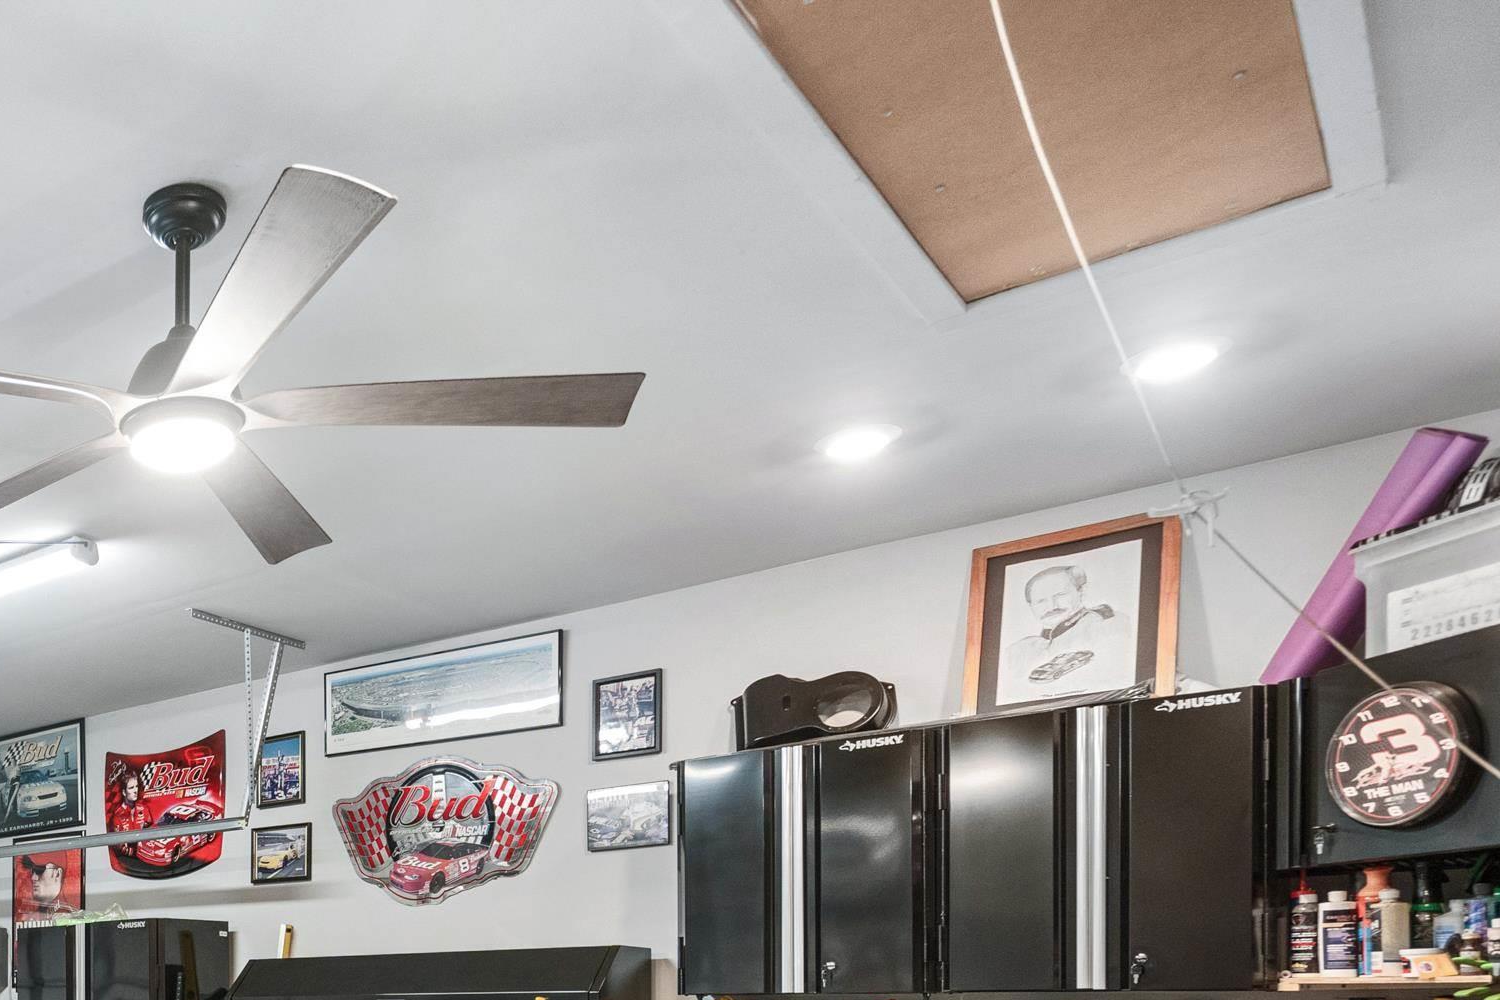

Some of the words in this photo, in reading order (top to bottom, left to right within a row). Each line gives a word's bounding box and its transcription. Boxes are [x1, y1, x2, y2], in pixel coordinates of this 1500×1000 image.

[1177, 690, 1242, 711] HUSKY
[1379, 695, 1400, 708] 12
[1429, 712, 1448, 724] 2
[855, 734, 904, 750] HUSKY
[1360, 713, 1441, 765] 3
[1439, 738, 1457, 750] 3
[19, 735, 63, 764] Bud
[149, 755, 215, 791] Bud
[1335, 761, 1350, 773] 9
[1433, 768, 1449, 779] 4
[1343, 786, 1358, 798] 8
[1363, 787, 1391, 800] THE
[1391, 779, 1425, 796] MAN
[389, 778, 497, 827] Bud
[1414, 792, 1430, 804] 5
[1362, 802, 1376, 813] 7
[1387, 805, 1403, 817] 6
[456, 824, 489, 838] NASCAR
[397, 856, 443, 870] Bud
[459, 858, 470, 873] 8
[124, 920, 146, 930] HUSKY
